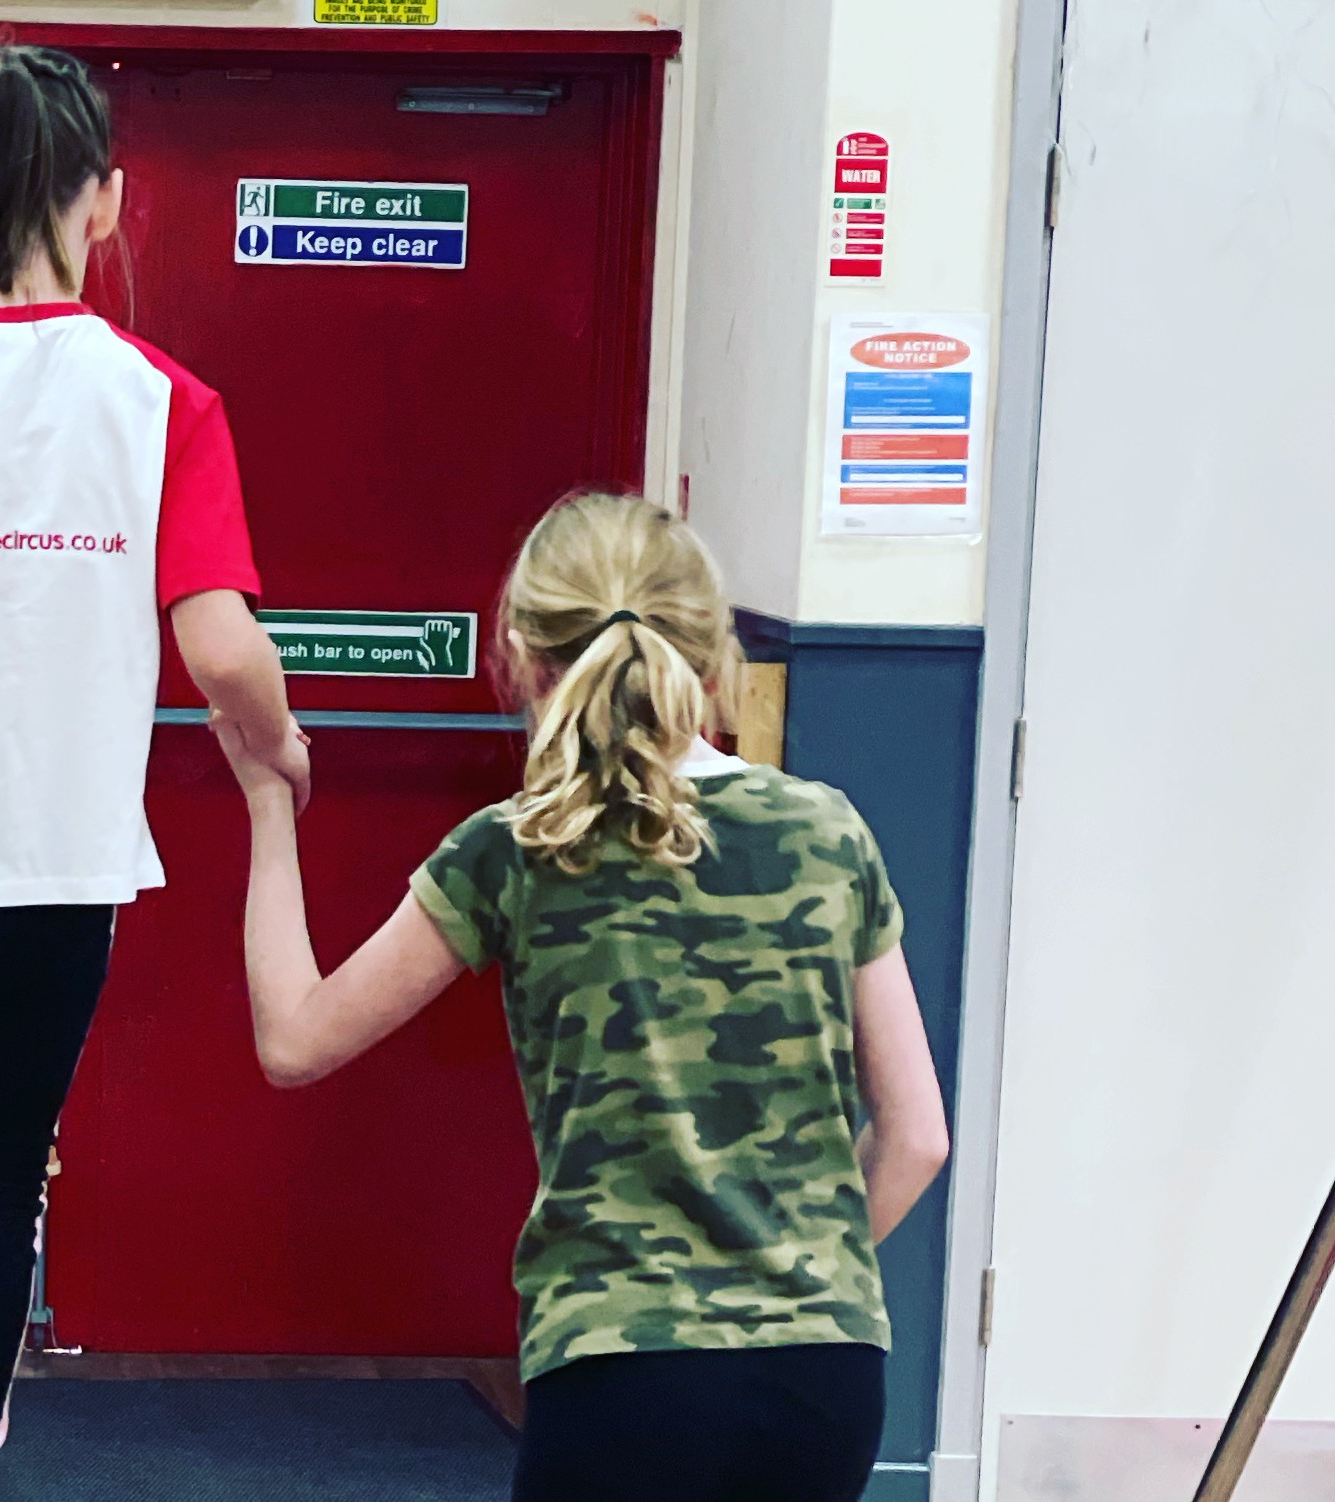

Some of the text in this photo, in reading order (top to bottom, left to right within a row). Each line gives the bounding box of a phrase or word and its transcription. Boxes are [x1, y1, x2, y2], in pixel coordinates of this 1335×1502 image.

[321, 13, 361, 21] PREVENTION
[380, 14, 402, 22] PUBLIC
[406, 15, 430, 23] SAFETY
[842, 169, 881, 183] WATER
[316, 191, 422, 217] Fire exit
[296, 230, 438, 260] Keep clear
[865, 341, 956, 352] FIRE ACTION
[883, 353, 938, 364] NOTICE
[276, 643, 413, 663] ush bar to open
